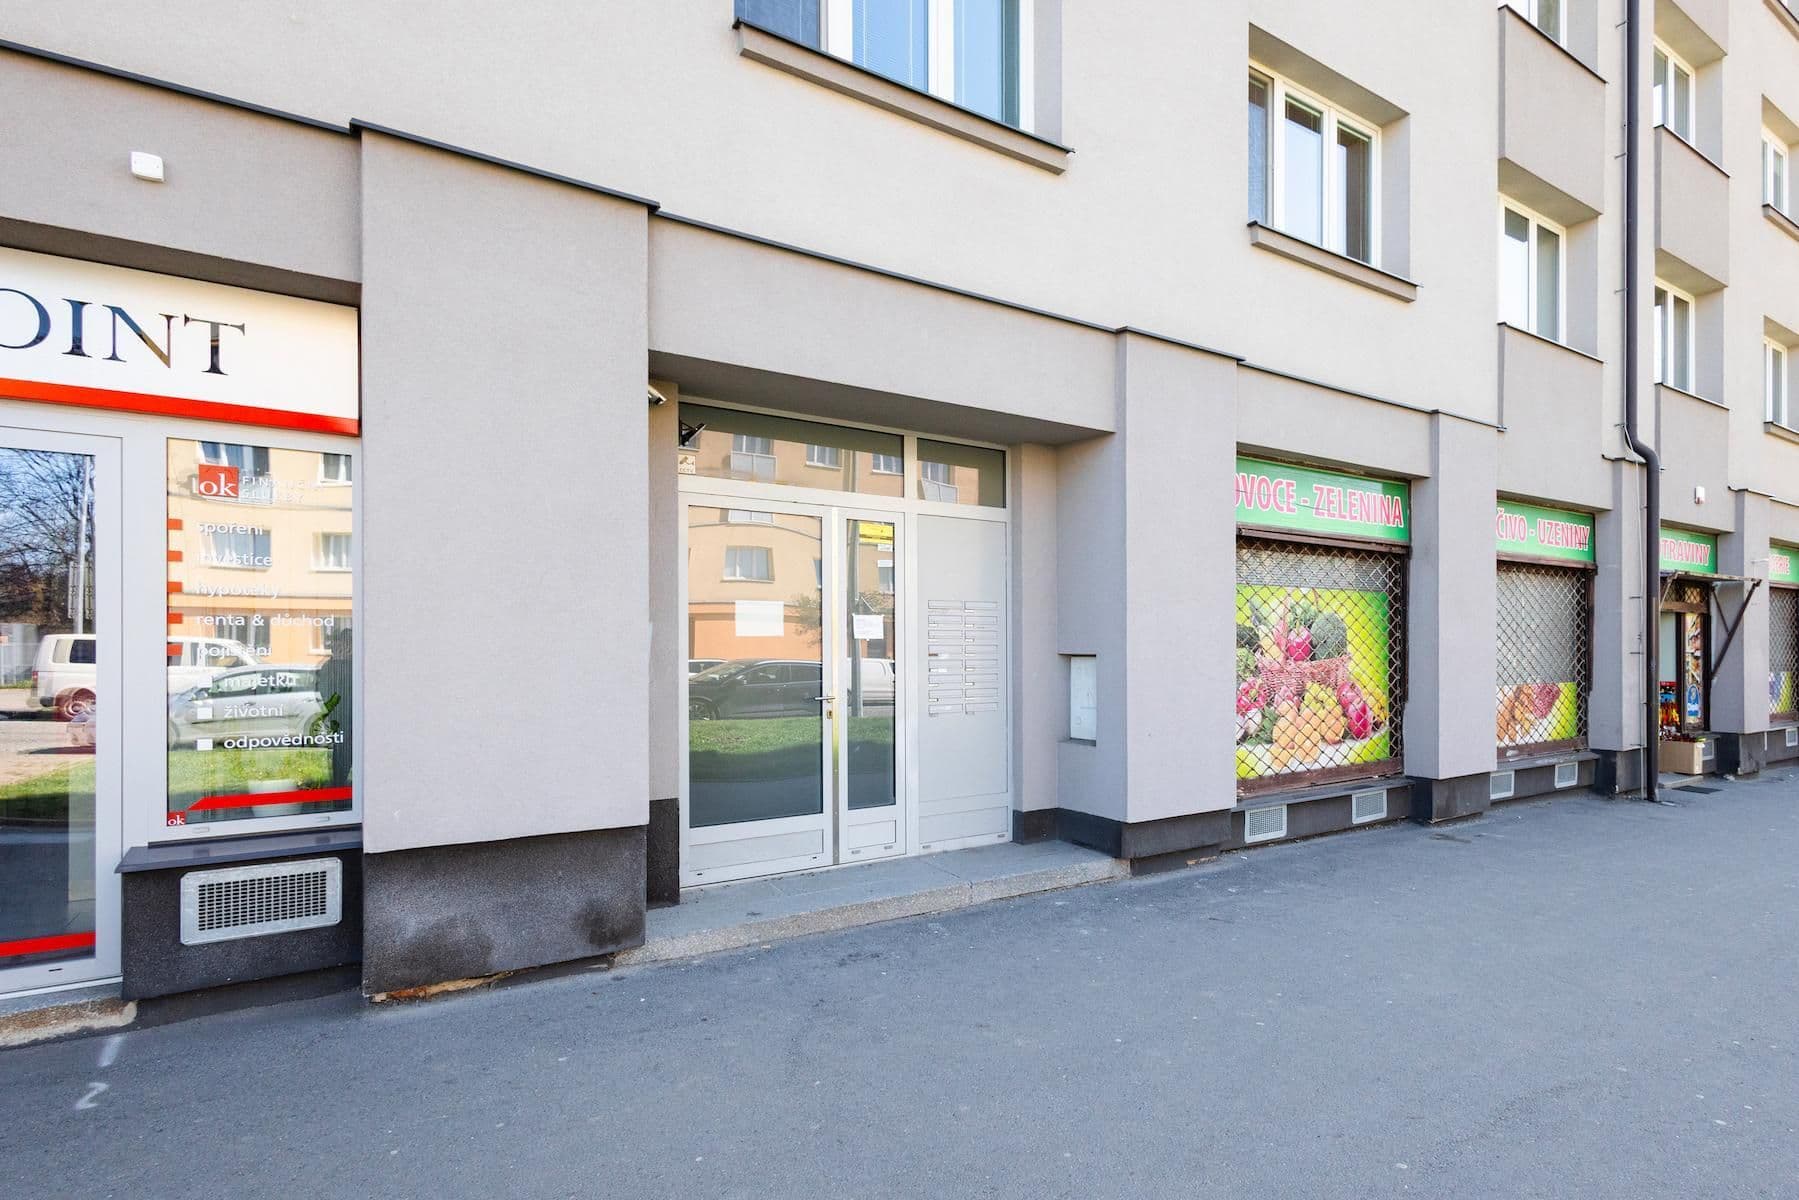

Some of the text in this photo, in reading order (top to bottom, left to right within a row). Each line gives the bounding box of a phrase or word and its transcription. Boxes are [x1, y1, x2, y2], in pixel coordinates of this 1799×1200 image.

[0, 288, 246, 376] OINT
[1313, 484, 1404, 528] ZELENINA
[1496, 507, 1527, 542] ČIVO
[1537, 518, 1590, 551] UZENINY
[197, 550, 273, 567] vestice
[1660, 538, 1711, 566] TRAVINY
[196, 614, 245, 626] renta
[223, 703, 284, 718] životní
[223, 731, 344, 751] odpovědnosti
[168, 815, 185, 826] ok
